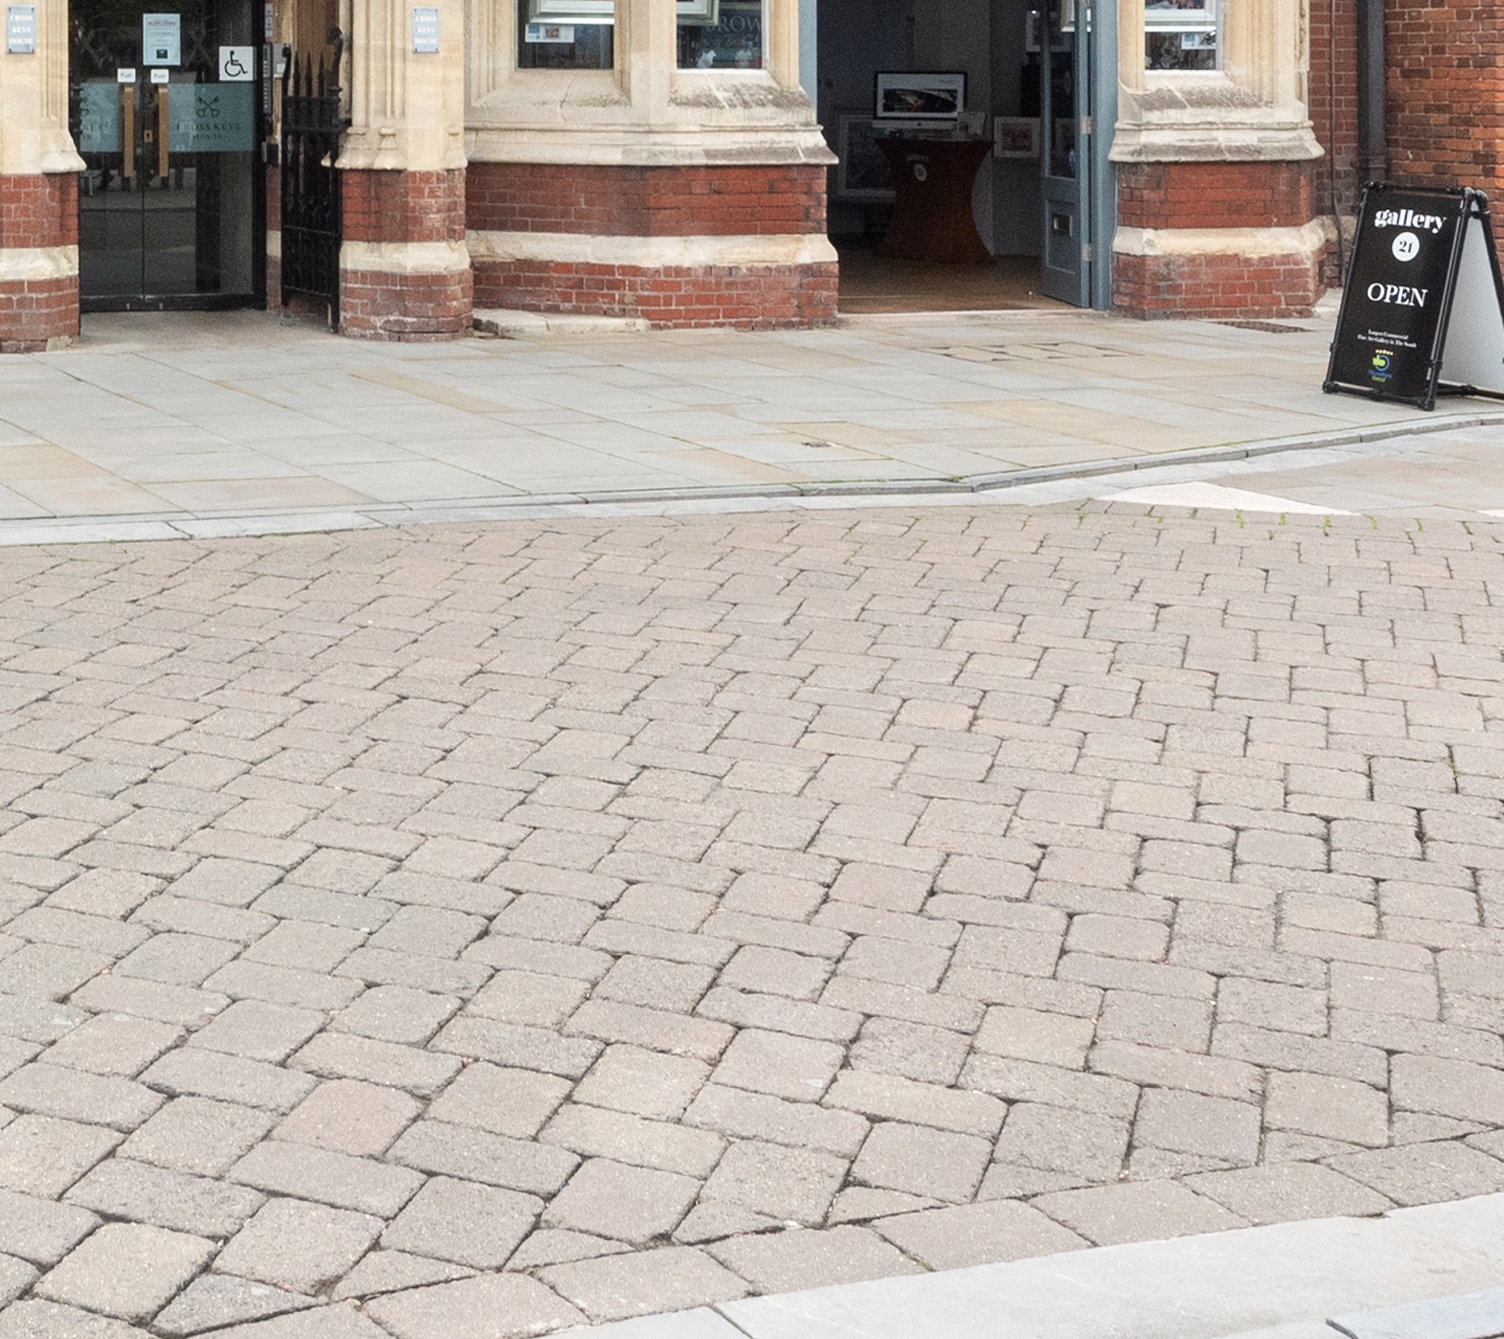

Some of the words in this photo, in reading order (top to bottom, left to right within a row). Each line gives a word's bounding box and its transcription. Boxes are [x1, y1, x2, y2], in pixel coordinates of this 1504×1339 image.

[9, 14, 34, 22] CROSS
[8, 37, 34, 45] HOUSE
[1374, 208, 1447, 234] gallery
[1398, 240, 1414, 253] 21
[1367, 282, 1428, 308] OPEN
